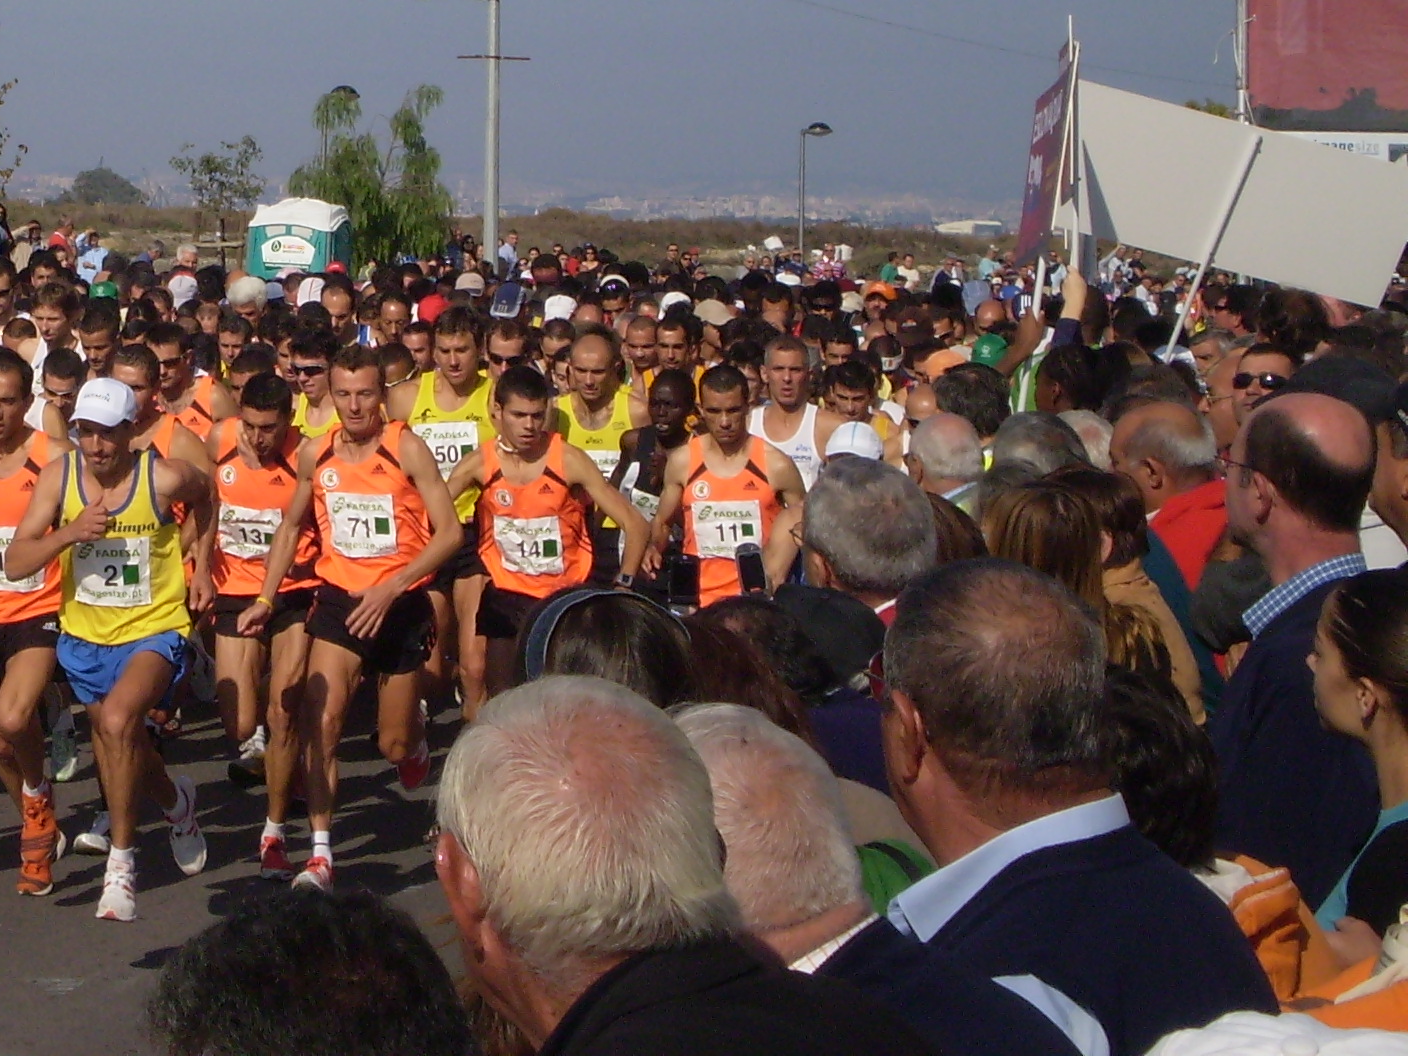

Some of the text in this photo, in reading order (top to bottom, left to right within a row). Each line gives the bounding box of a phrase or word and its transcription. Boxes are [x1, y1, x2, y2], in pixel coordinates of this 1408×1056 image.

[435, 444, 459, 464] 50
[713, 510, 752, 519] FADESA
[239, 527, 263, 545] 13
[347, 517, 370, 539] 71
[715, 523, 738, 542] 11
[95, 549, 141, 558] FADESA
[517, 540, 541, 558] 14
[104, 565, 118, 586] 2
